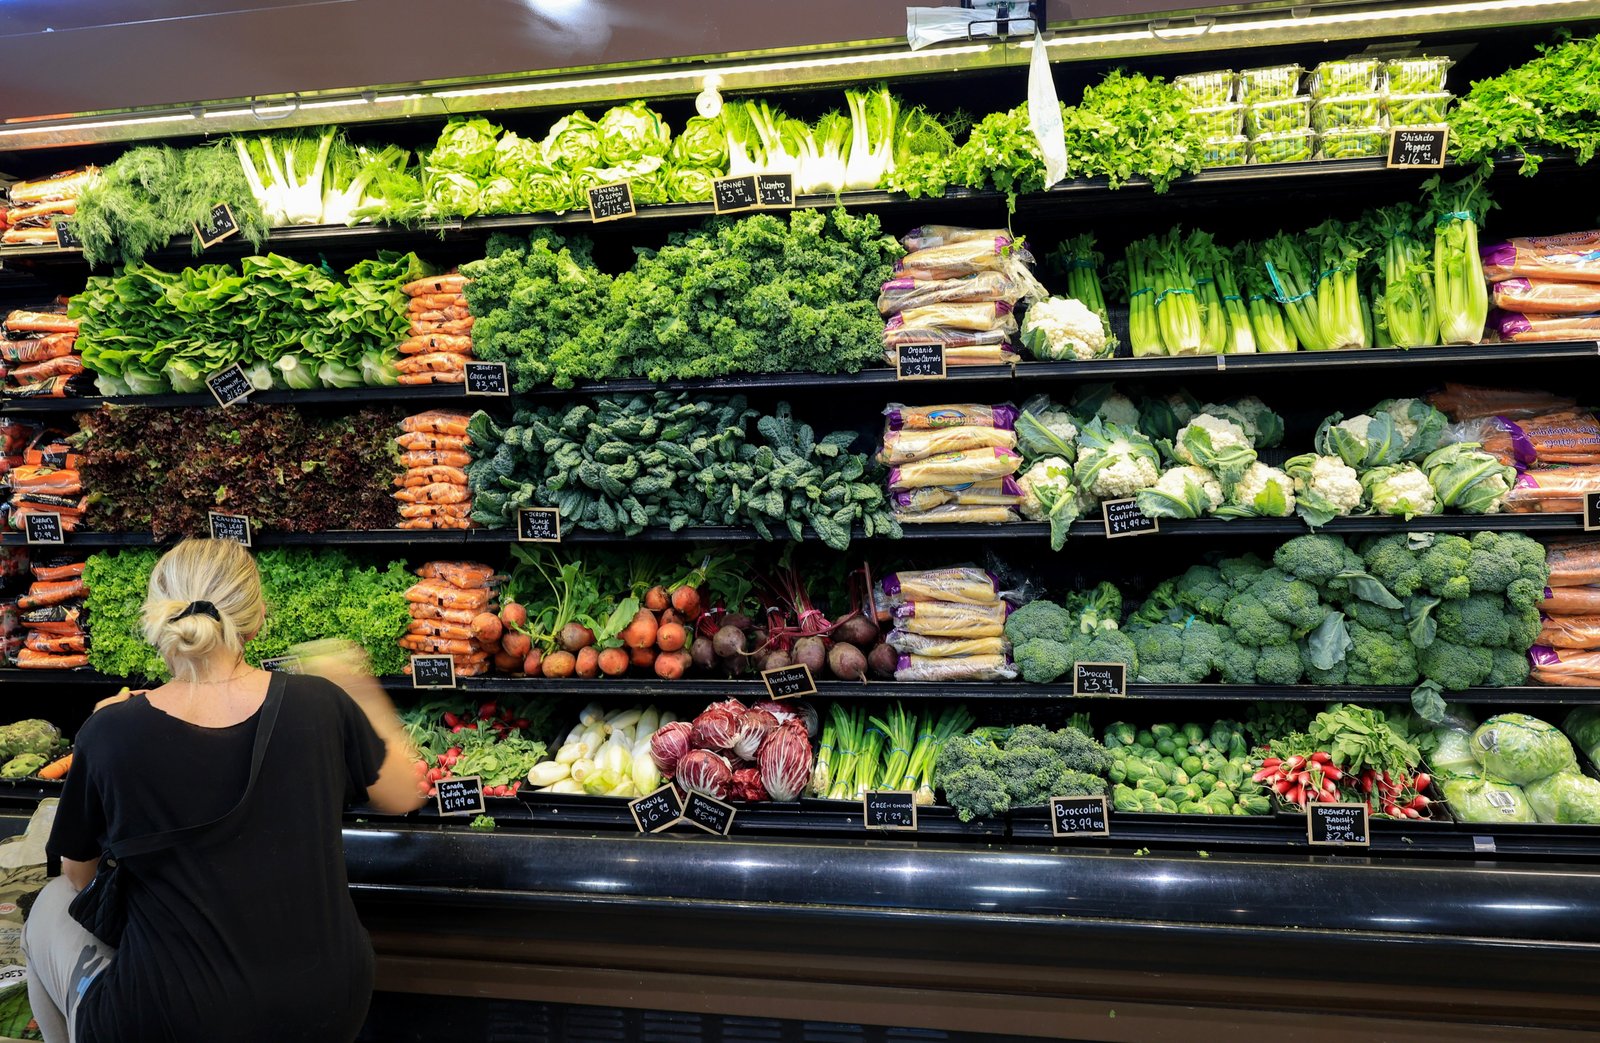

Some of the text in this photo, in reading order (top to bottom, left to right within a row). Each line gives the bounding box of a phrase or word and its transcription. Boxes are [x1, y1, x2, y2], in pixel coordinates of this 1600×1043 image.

[1405, 142, 1431, 153] Peppers
[717, 180, 746, 191] FENNEL
[598, 190, 623, 202] BOSTON
[475, 379, 498, 391] $3.99
[1113, 518, 1140, 532] $4.99
[527, 529, 551, 538] $3.99
[1078, 666, 1111, 680] Broccoli
[1083, 678, 1114, 692] $3.99
[441, 782, 465, 790] Canada
[441, 789, 461, 799] Radish
[444, 797, 466, 810] $1.99
[635, 796, 665, 813] Endive
[870, 801, 892, 809] GREEN
[1055, 802, 1102, 817] Broccolini
[694, 807, 717, 824] $5.99
[1317, 808, 1361, 816] BREAKFAST
[1061, 817, 1105, 831] $3.99 ea
